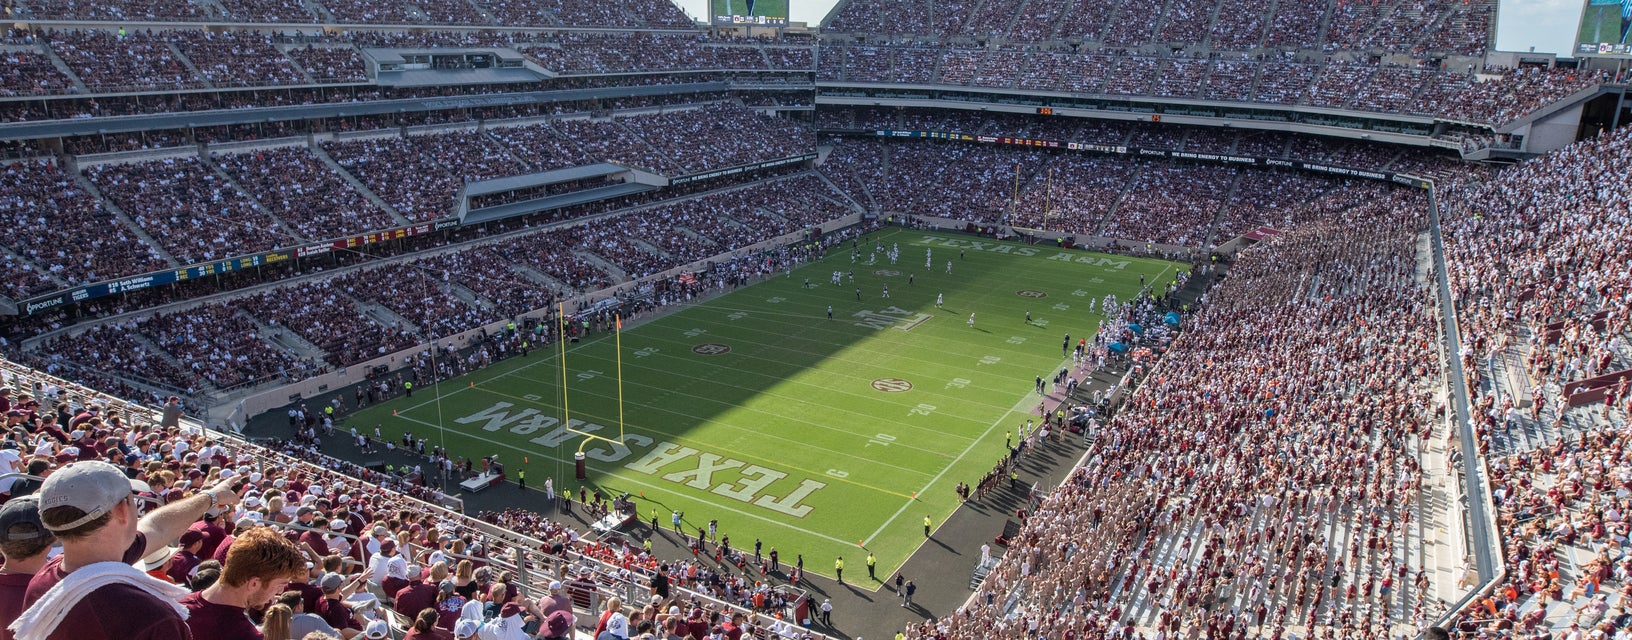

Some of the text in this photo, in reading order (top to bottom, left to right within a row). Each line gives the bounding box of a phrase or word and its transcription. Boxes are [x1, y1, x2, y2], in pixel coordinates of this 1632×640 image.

[1359, 171, 1385, 179] BUSINESS
[920, 235, 1132, 269] TEXAS A&M
[73, 293, 89, 301] TIGERS
[26, 296, 63, 315] OPPORTUNE
[576, 370, 604, 379] 10
[910, 404, 936, 416] 20
[454, 401, 604, 448] A&M
[869, 433, 896, 446] 10
[586, 433, 828, 518] TEXAS
[826, 469, 849, 478] G
[45, 495, 69, 504] AGGIES
